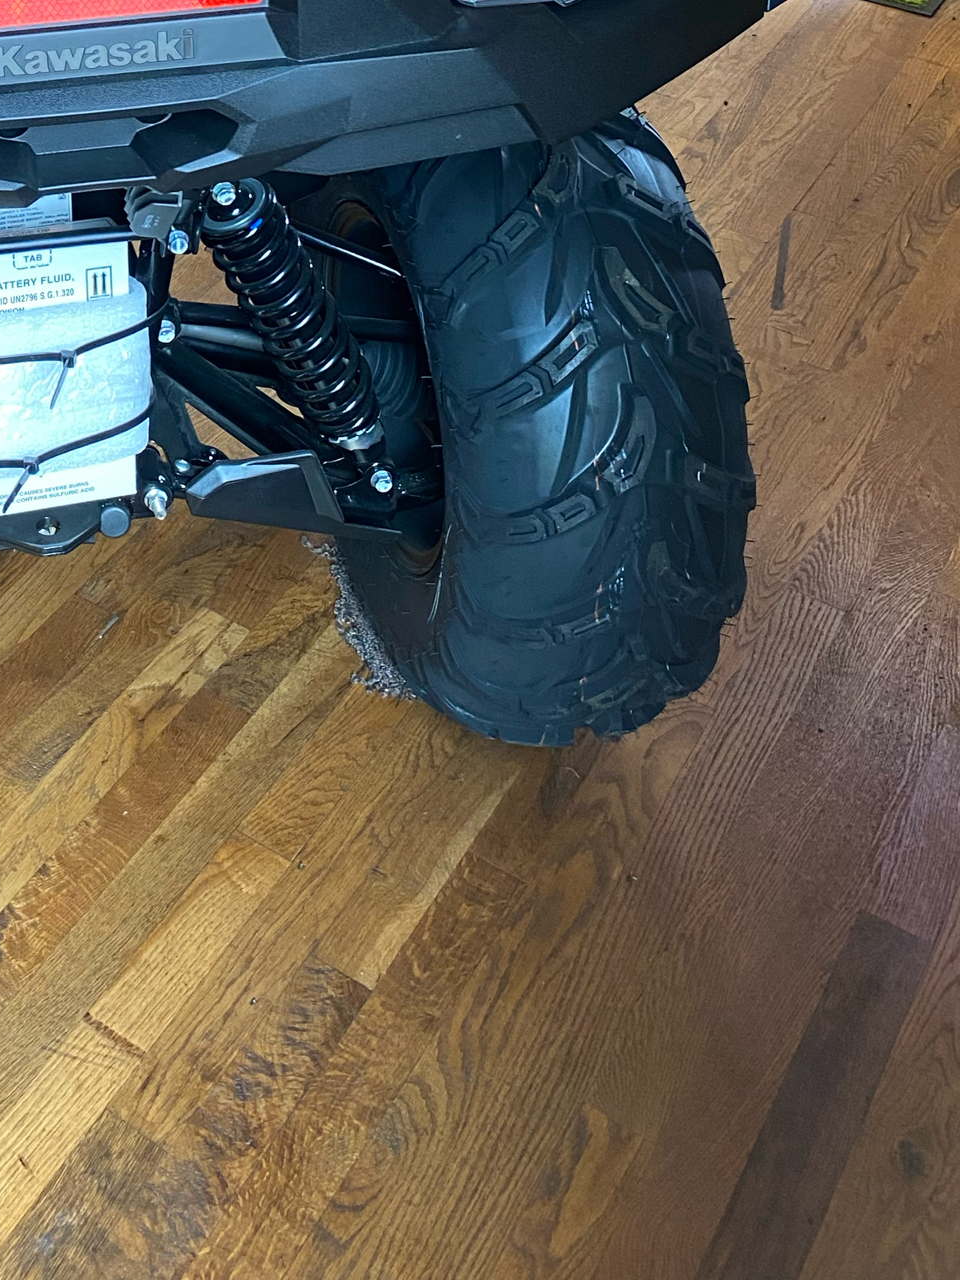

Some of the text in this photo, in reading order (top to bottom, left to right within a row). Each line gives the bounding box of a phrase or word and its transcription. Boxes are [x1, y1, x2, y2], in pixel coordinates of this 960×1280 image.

[23, 254, 42, 263] TAB
[40, 273, 75, 285] FLUID,
[10, 293, 37, 303] UN2796
